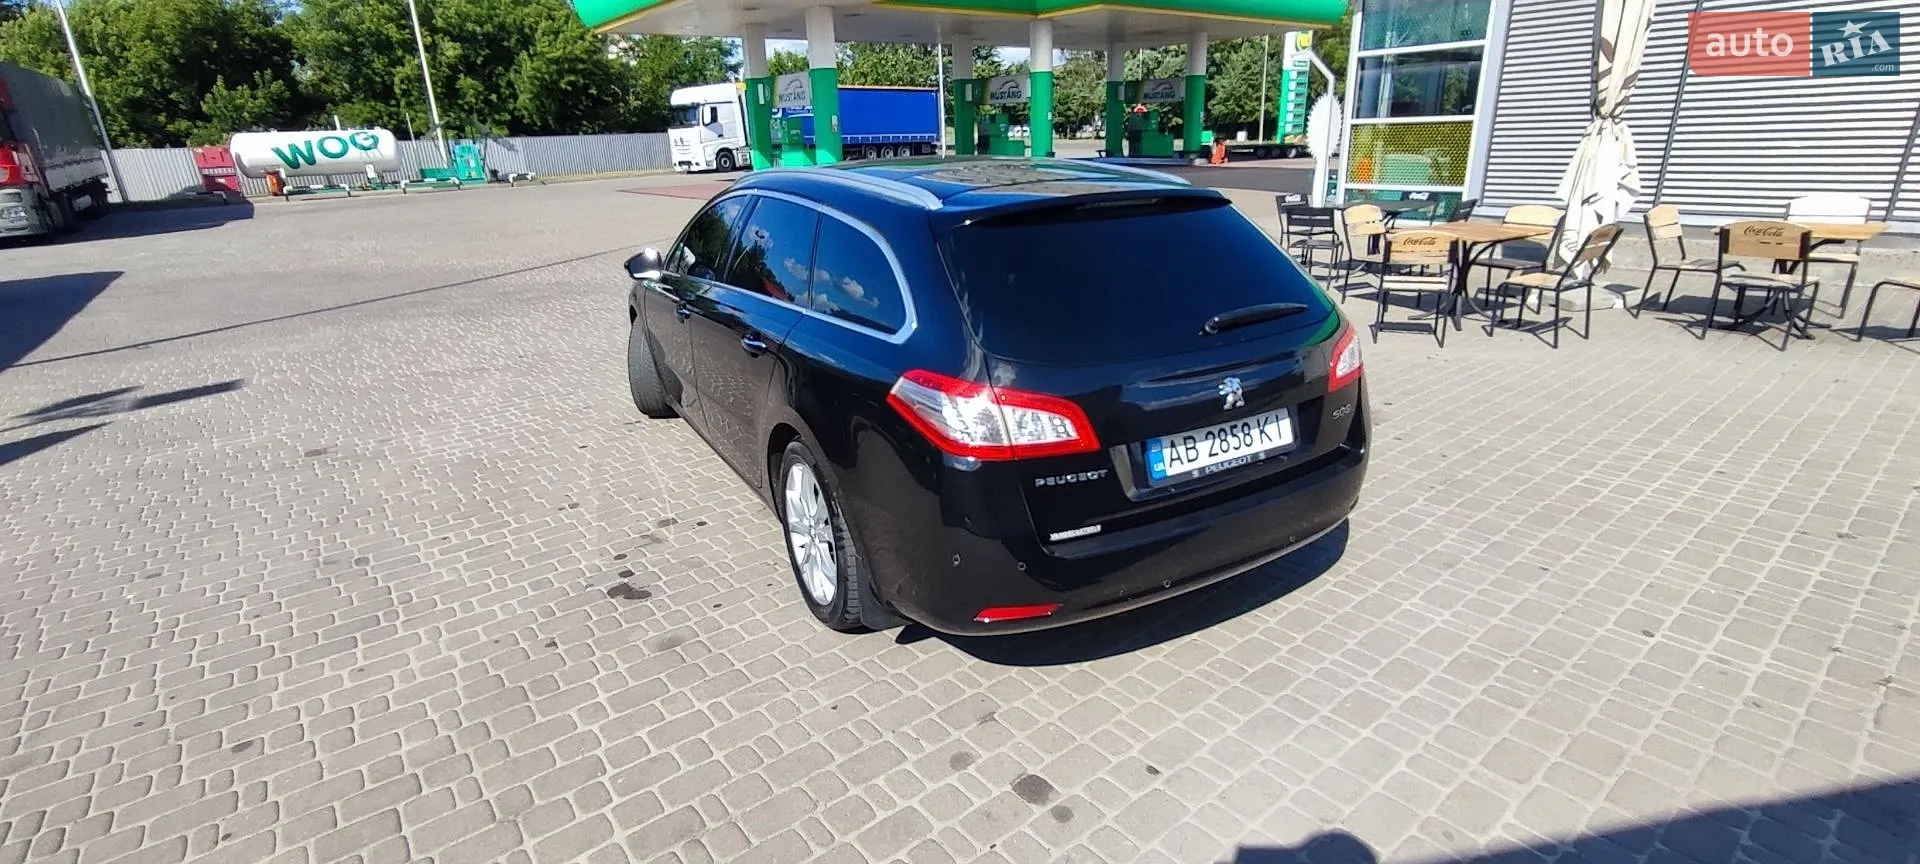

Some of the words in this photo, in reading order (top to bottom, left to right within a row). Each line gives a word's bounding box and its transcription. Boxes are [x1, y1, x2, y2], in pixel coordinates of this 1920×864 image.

[990, 90, 1022, 100] MUSTANG
[271, 132, 380, 170] WOG
[1168, 435, 1199, 468] AB
[1205, 422, 1253, 458] 2858
[1256, 414, 1283, 445] KI
[1204, 456, 1252, 474] PEUGEOT
[1034, 469, 1109, 488] PEUGEOT
